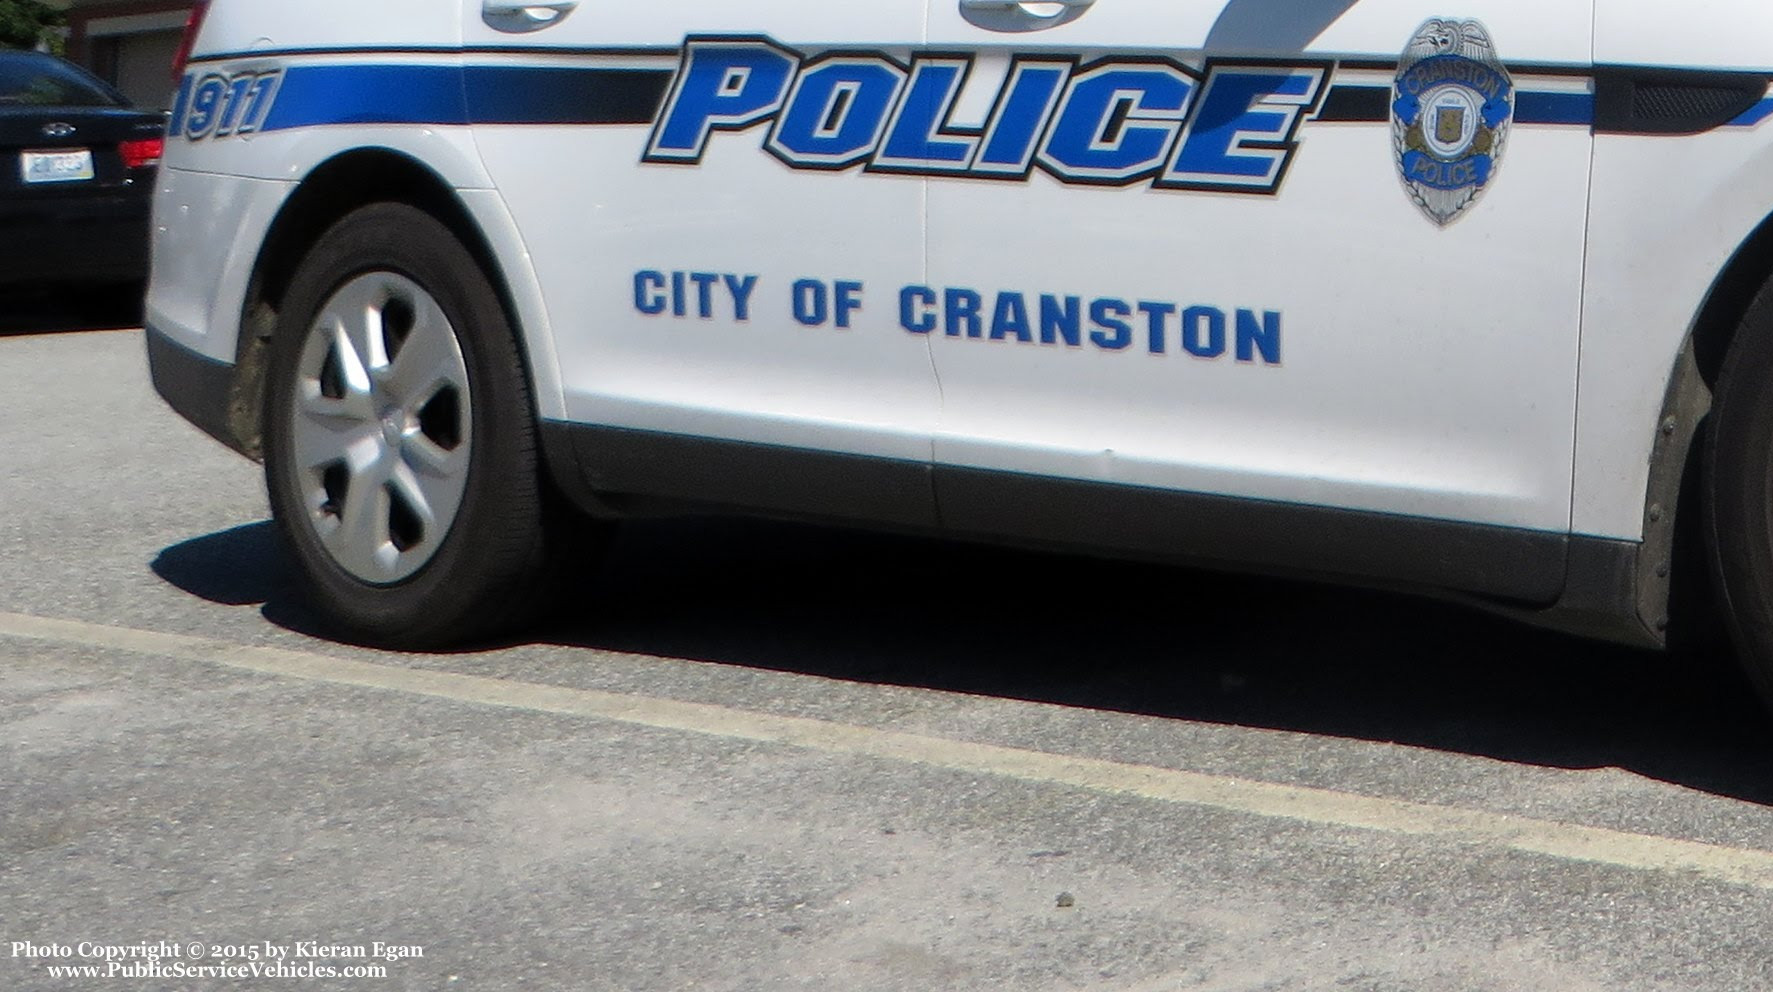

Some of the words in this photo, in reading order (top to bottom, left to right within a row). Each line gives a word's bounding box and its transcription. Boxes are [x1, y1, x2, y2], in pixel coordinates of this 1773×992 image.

[184, 69, 284, 141] 911
[640, 33, 1334, 196] POLICE
[1406, 59, 1499, 99] CRANSTON
[1412, 159, 1477, 186] POLICE
[633, 269, 758, 320] CITY
[791, 278, 863, 327] OF
[899, 285, 1282, 364] CRANSTON
